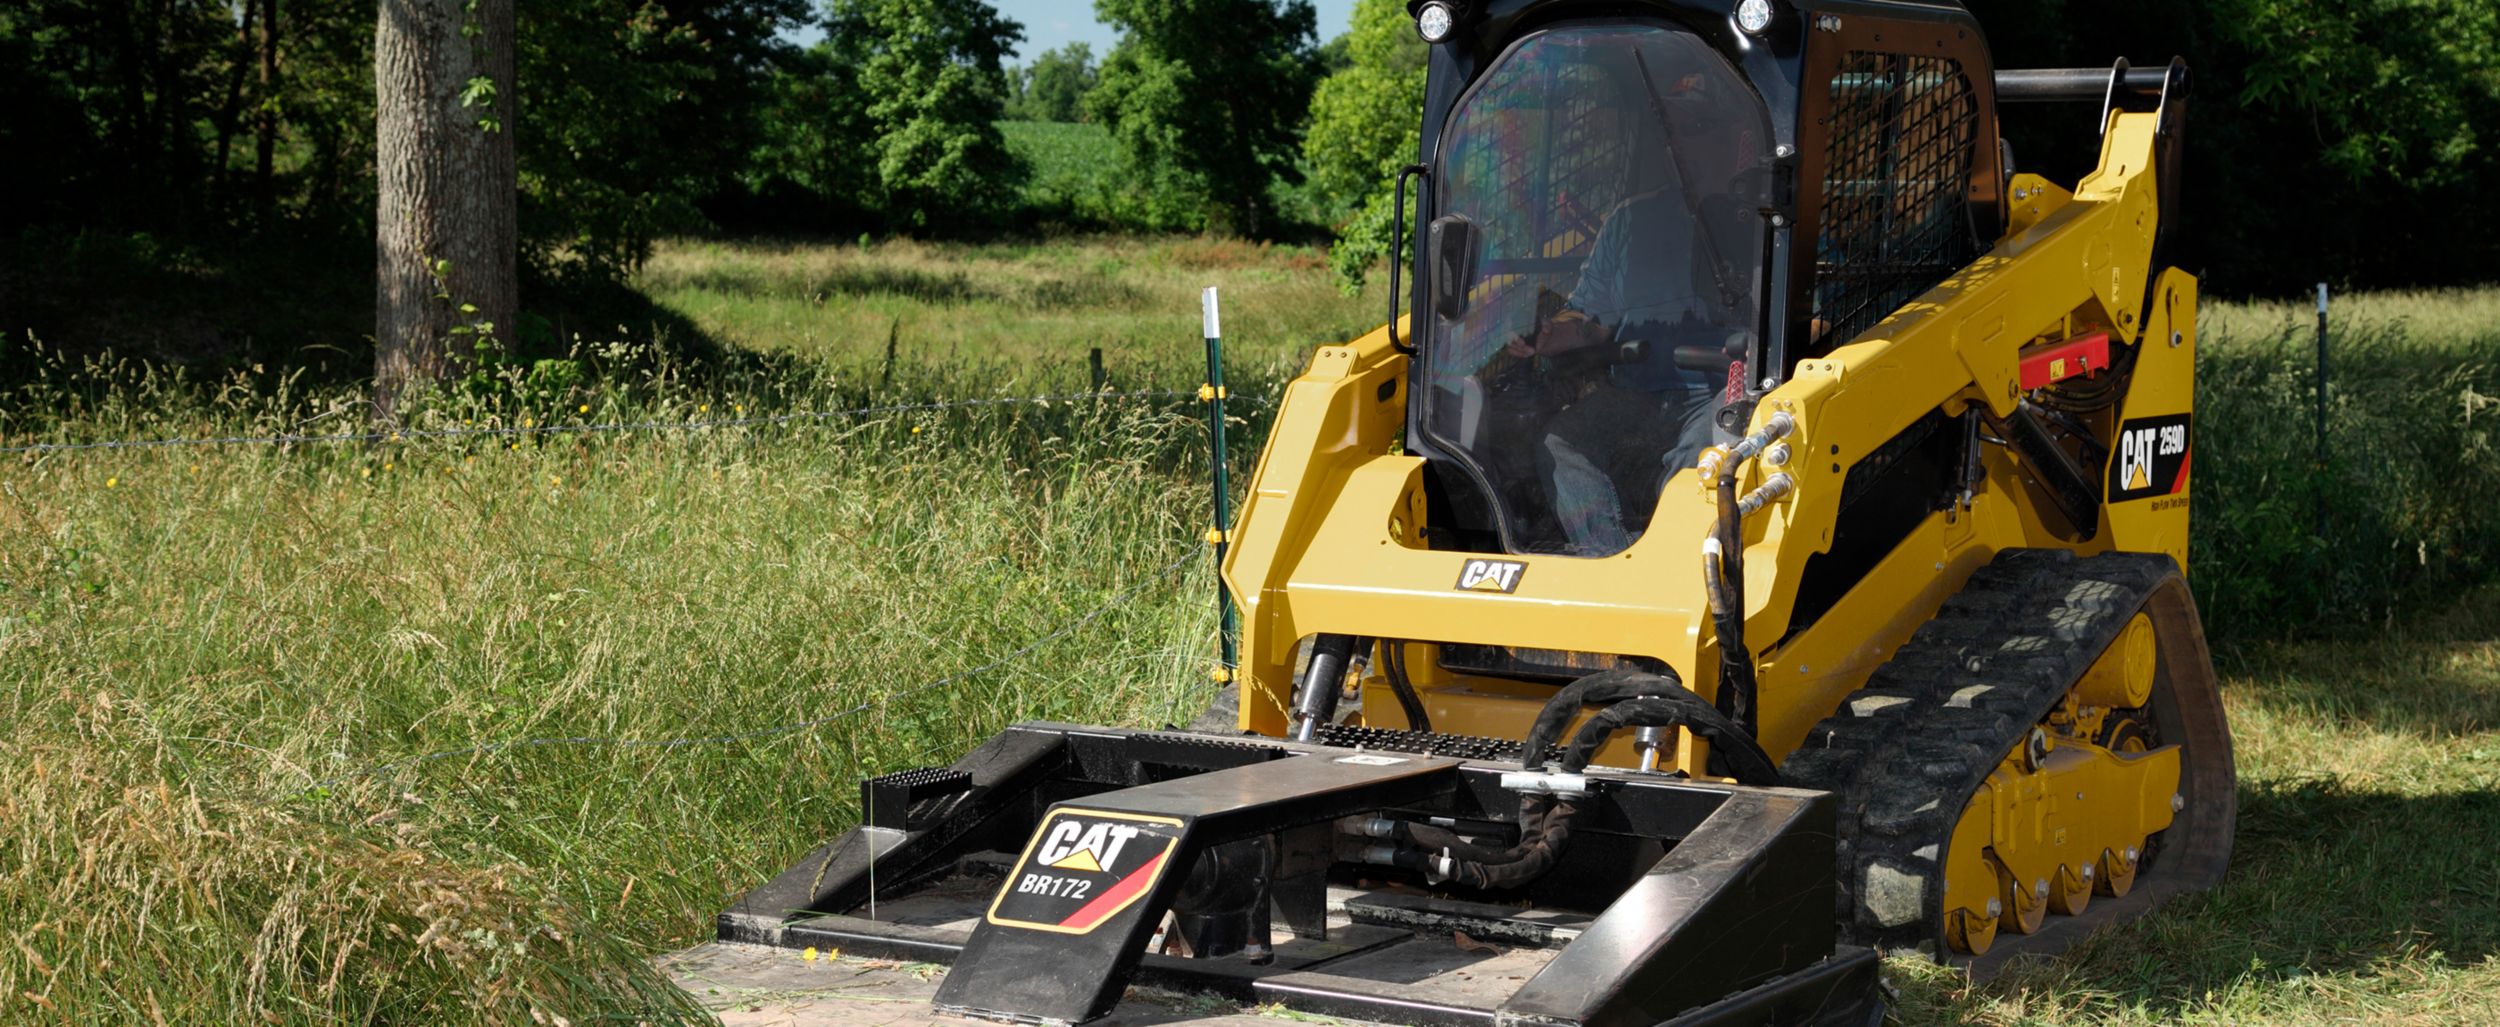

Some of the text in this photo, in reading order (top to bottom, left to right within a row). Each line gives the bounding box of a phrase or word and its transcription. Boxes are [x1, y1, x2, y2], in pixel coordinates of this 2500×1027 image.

[2121, 424, 2185, 491] CAT 259D
[1461, 560, 1521, 591] CAT
[1037, 820, 1139, 873] CAT
[1017, 873, 1092, 900] BR172
